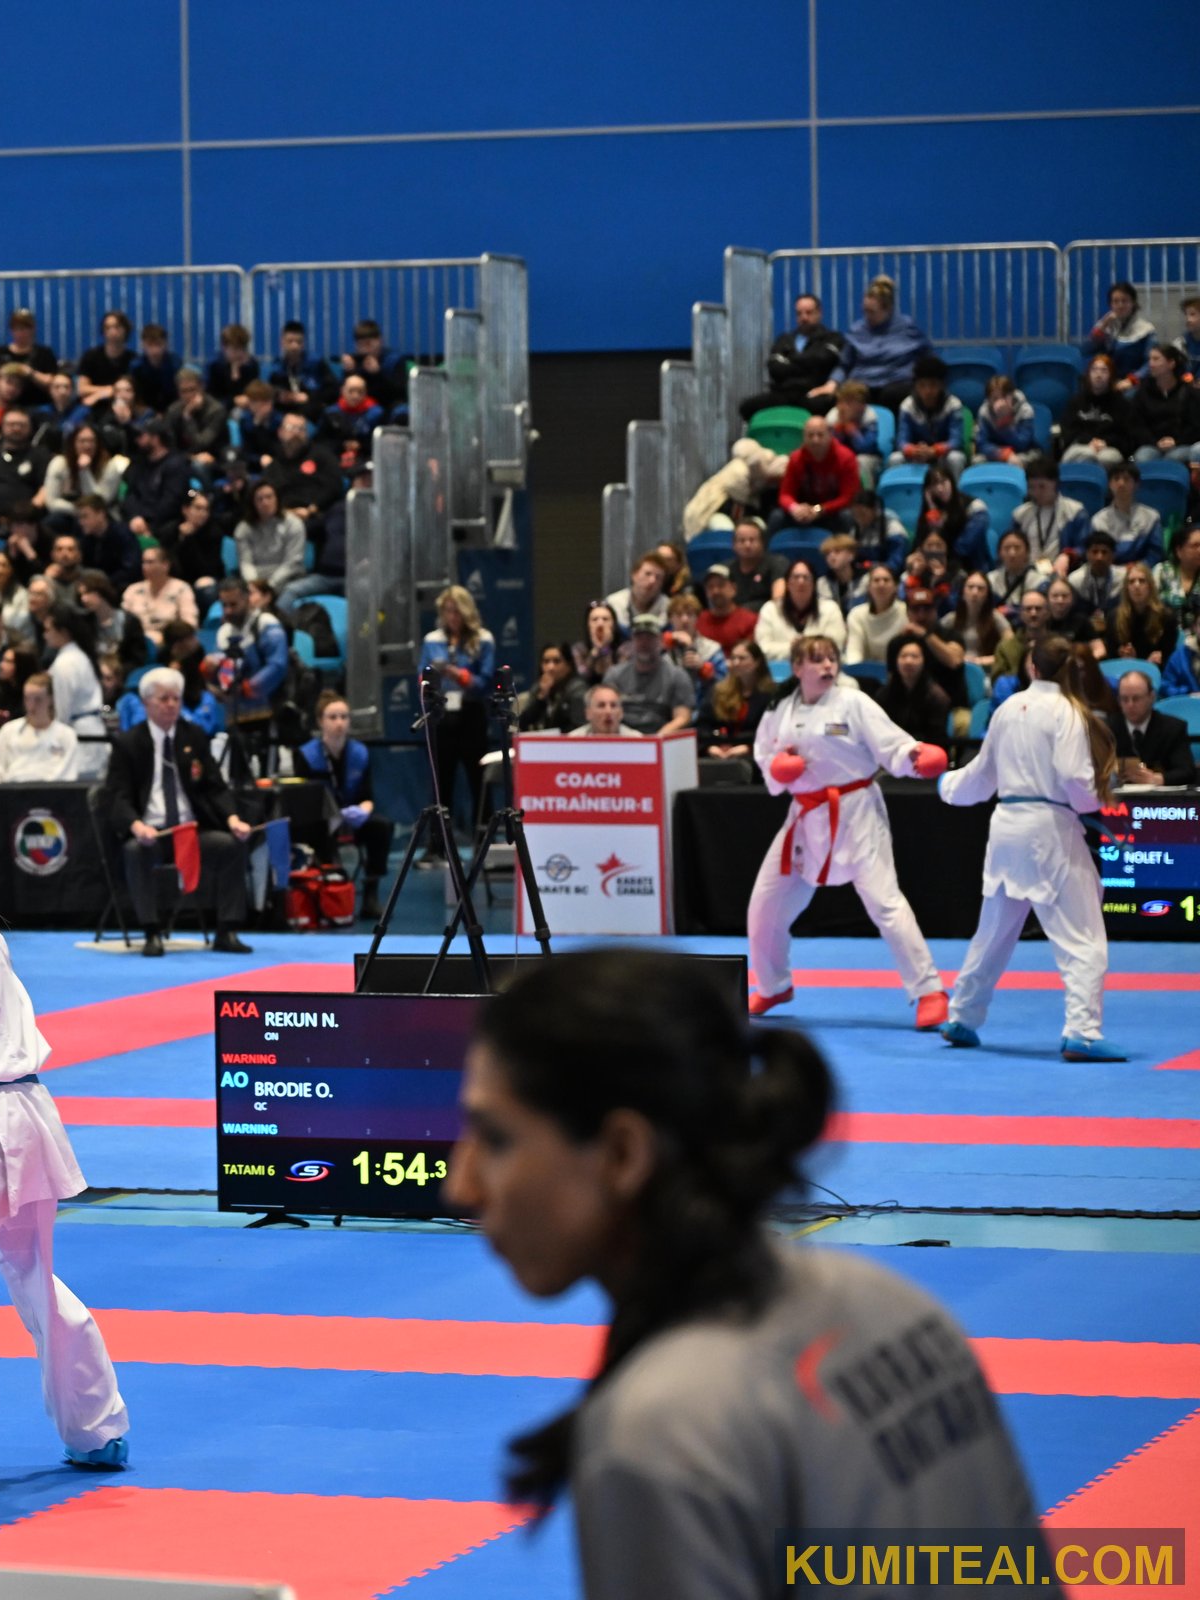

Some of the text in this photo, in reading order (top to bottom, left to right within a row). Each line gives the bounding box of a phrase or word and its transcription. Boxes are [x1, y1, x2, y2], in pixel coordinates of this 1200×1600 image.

[555, 772, 621, 788] COACH
[1132, 806, 1187, 821] DAVISON
[1123, 851, 1162, 865] NOLET
[616, 876, 653, 886] KARATE
[220, 1001, 259, 1018] AKA
[264, 1011, 339, 1028] REKUN N.
[264, 1032, 279, 1041] ON
[222, 1053, 277, 1065] WARNING
[220, 1071, 249, 1088] AO
[254, 1081, 334, 1098] BRODIE O.
[254, 1102, 268, 1111] QC
[223, 1123, 278, 1135] WARNING
[223, 1163, 276, 1176] TATAMI 6
[352, 1151, 448, 1186] 1:54.3
